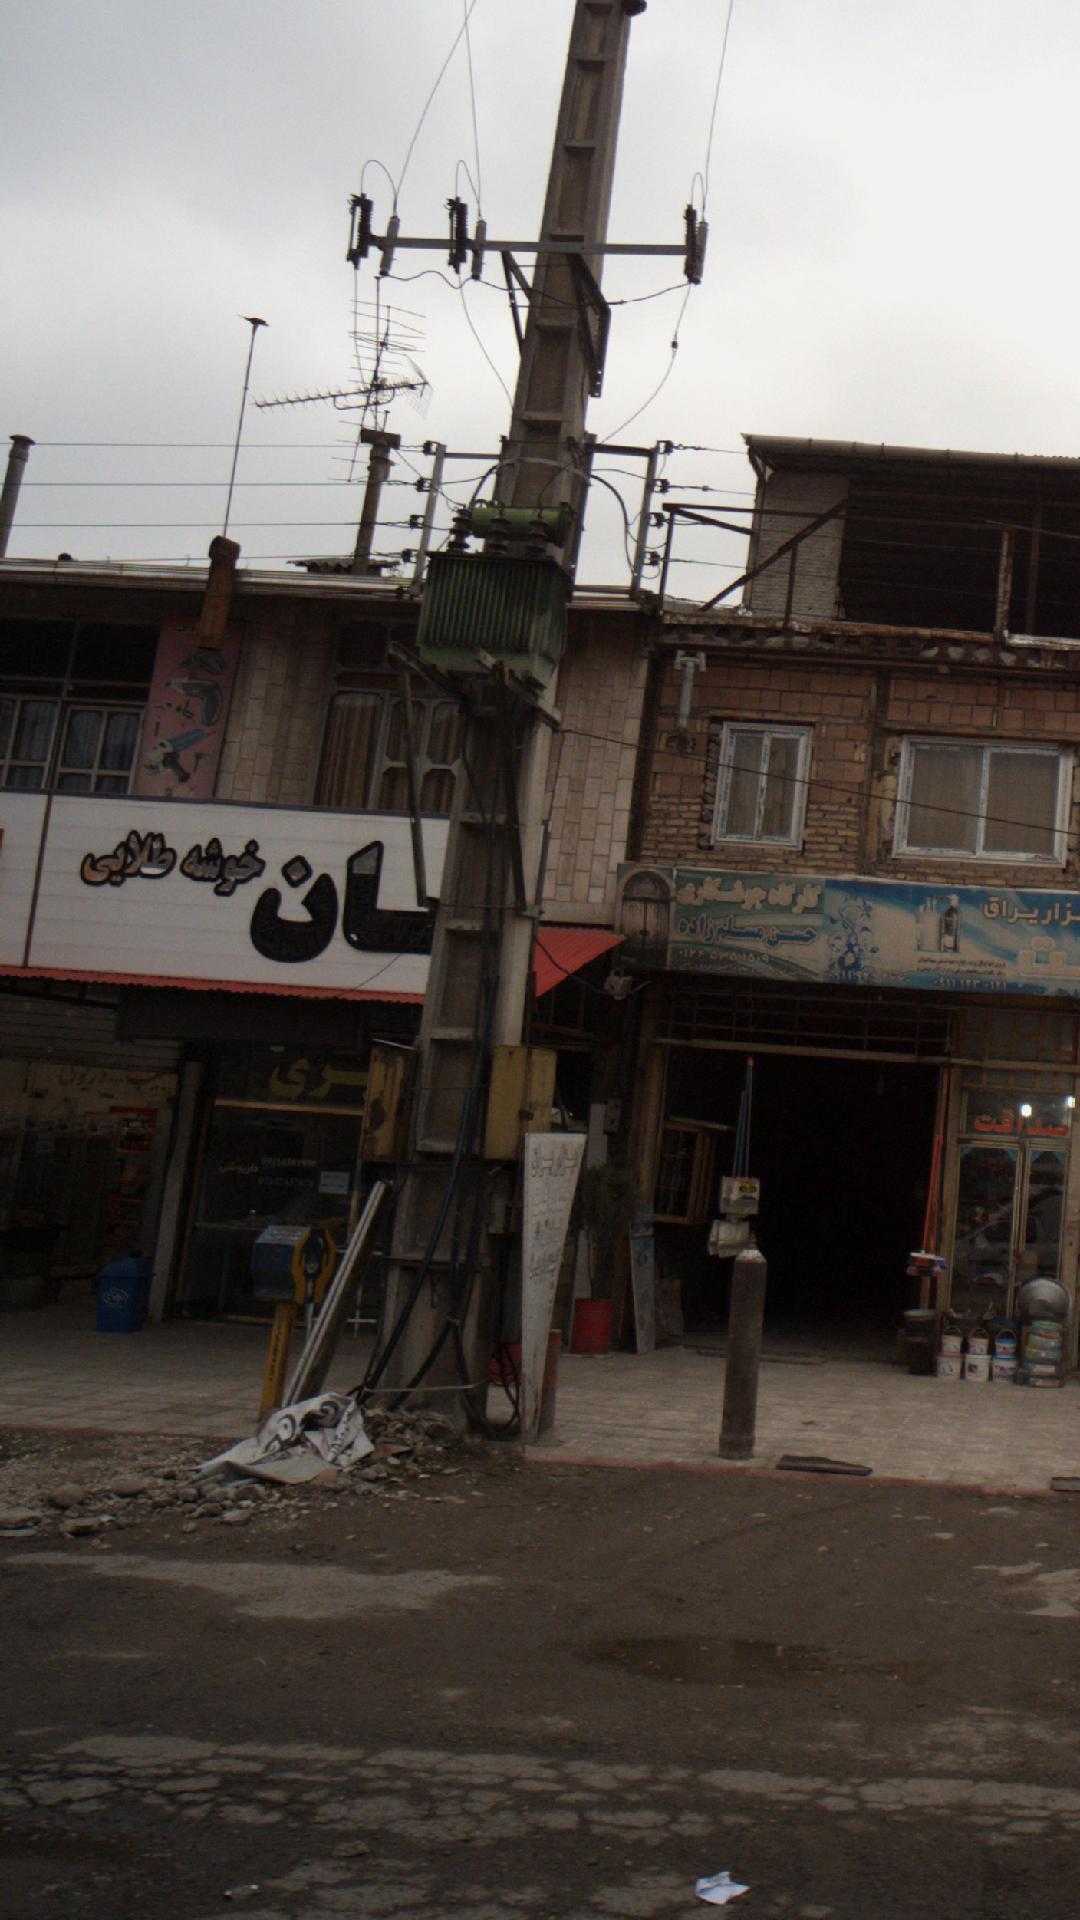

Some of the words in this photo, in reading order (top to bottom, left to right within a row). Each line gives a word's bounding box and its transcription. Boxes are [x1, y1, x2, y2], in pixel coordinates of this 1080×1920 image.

[80, 829, 177, 886] طلایی
[180, 837, 266, 896] خوشه
[677, 876, 768, 911] جوشکاری
[767, 882, 822, 915] کارگاه
[716, 914, 765, 943] مسلم
[765, 926, 817, 948] حسن
